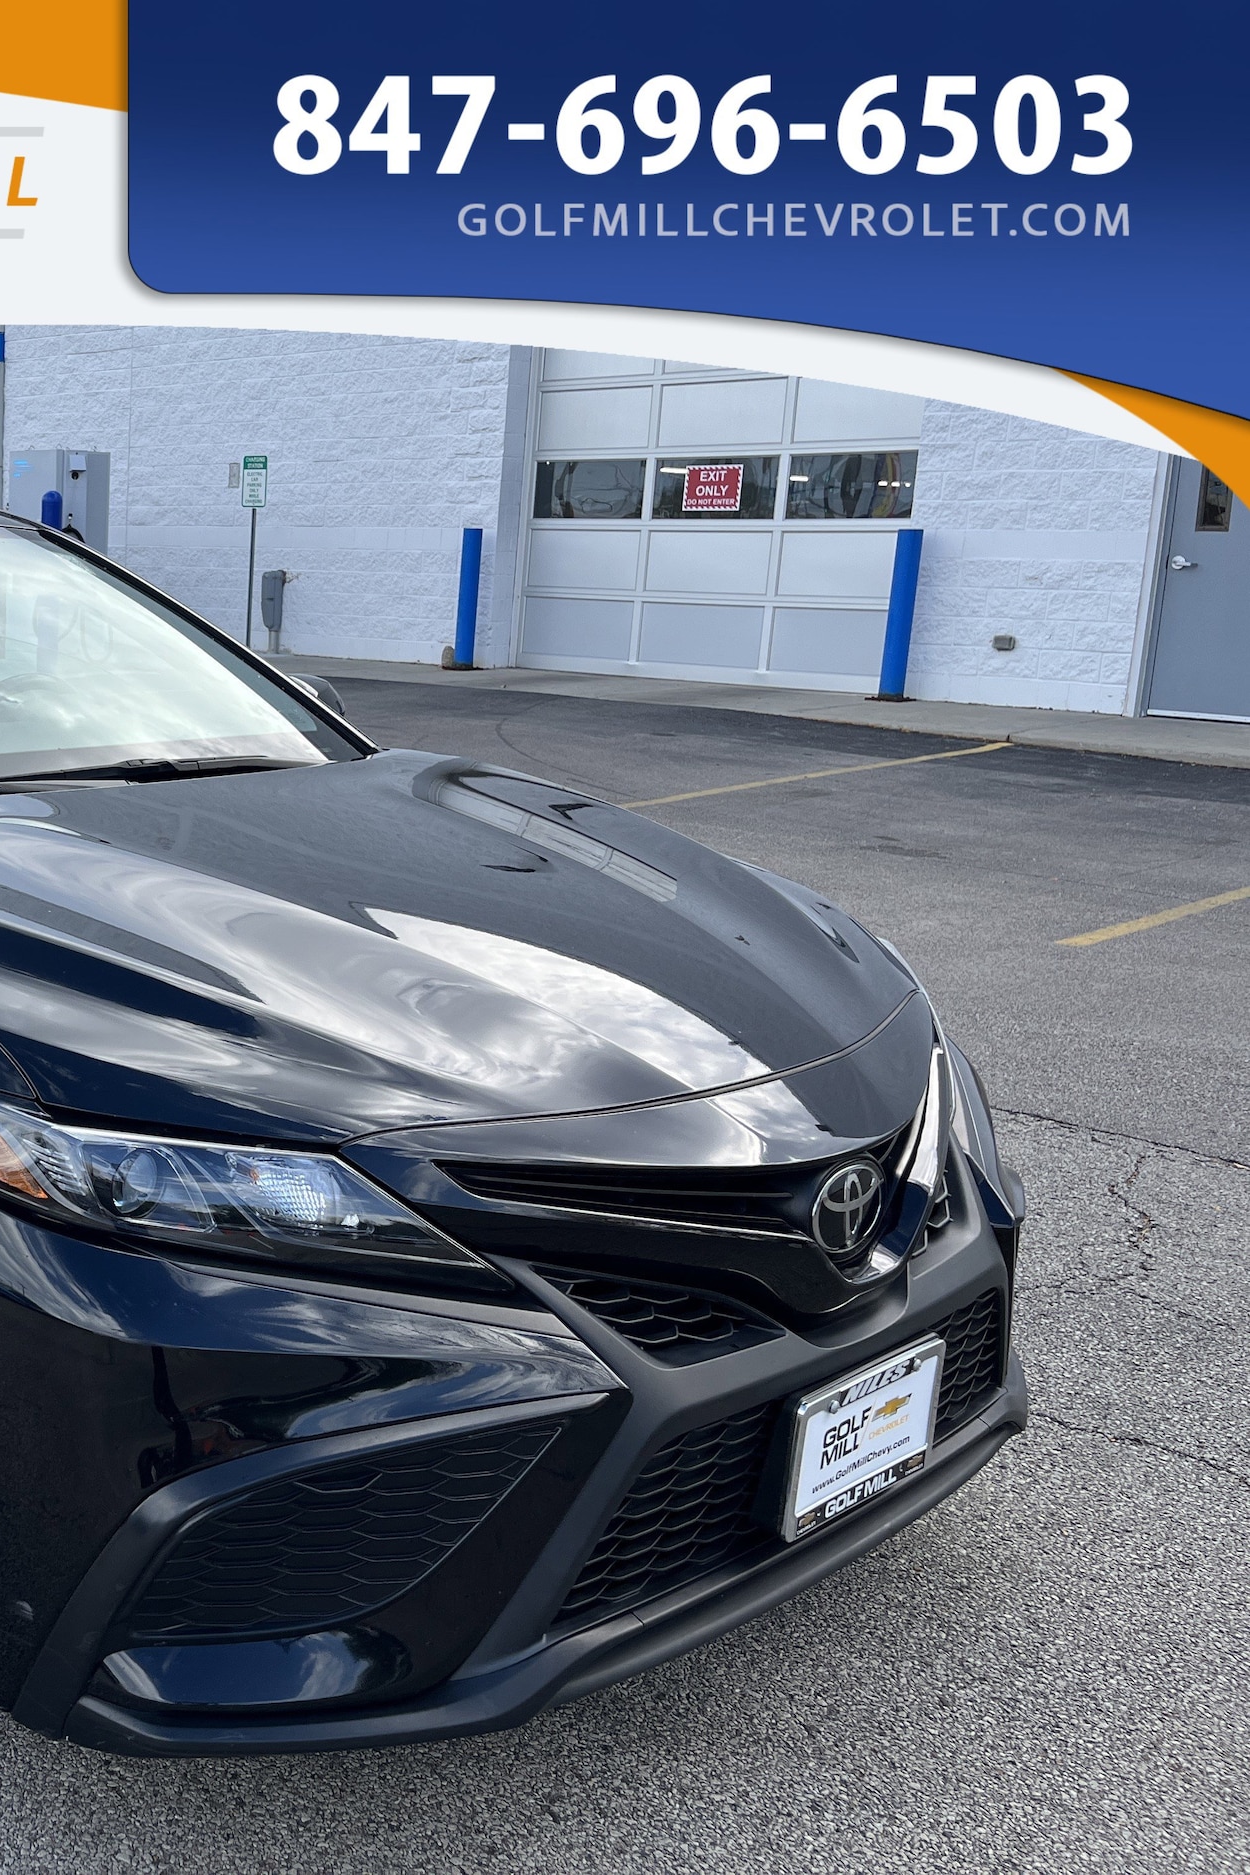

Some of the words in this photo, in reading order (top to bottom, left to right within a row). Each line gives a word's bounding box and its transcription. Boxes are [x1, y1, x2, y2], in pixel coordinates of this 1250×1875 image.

[695, 485, 729, 497] ONLY
[699, 470, 728, 482] EXIT
[841, 1358, 911, 1406] NILES
[823, 1405, 872, 1449] GOLF
[868, 1414, 910, 1440] CHEVROLET
[811, 1435, 911, 1494] www.GolfMillChevy.com
[820, 1435, 859, 1470] MILL
[825, 1487, 865, 1519] GOLF
[864, 1468, 897, 1499] MILL
